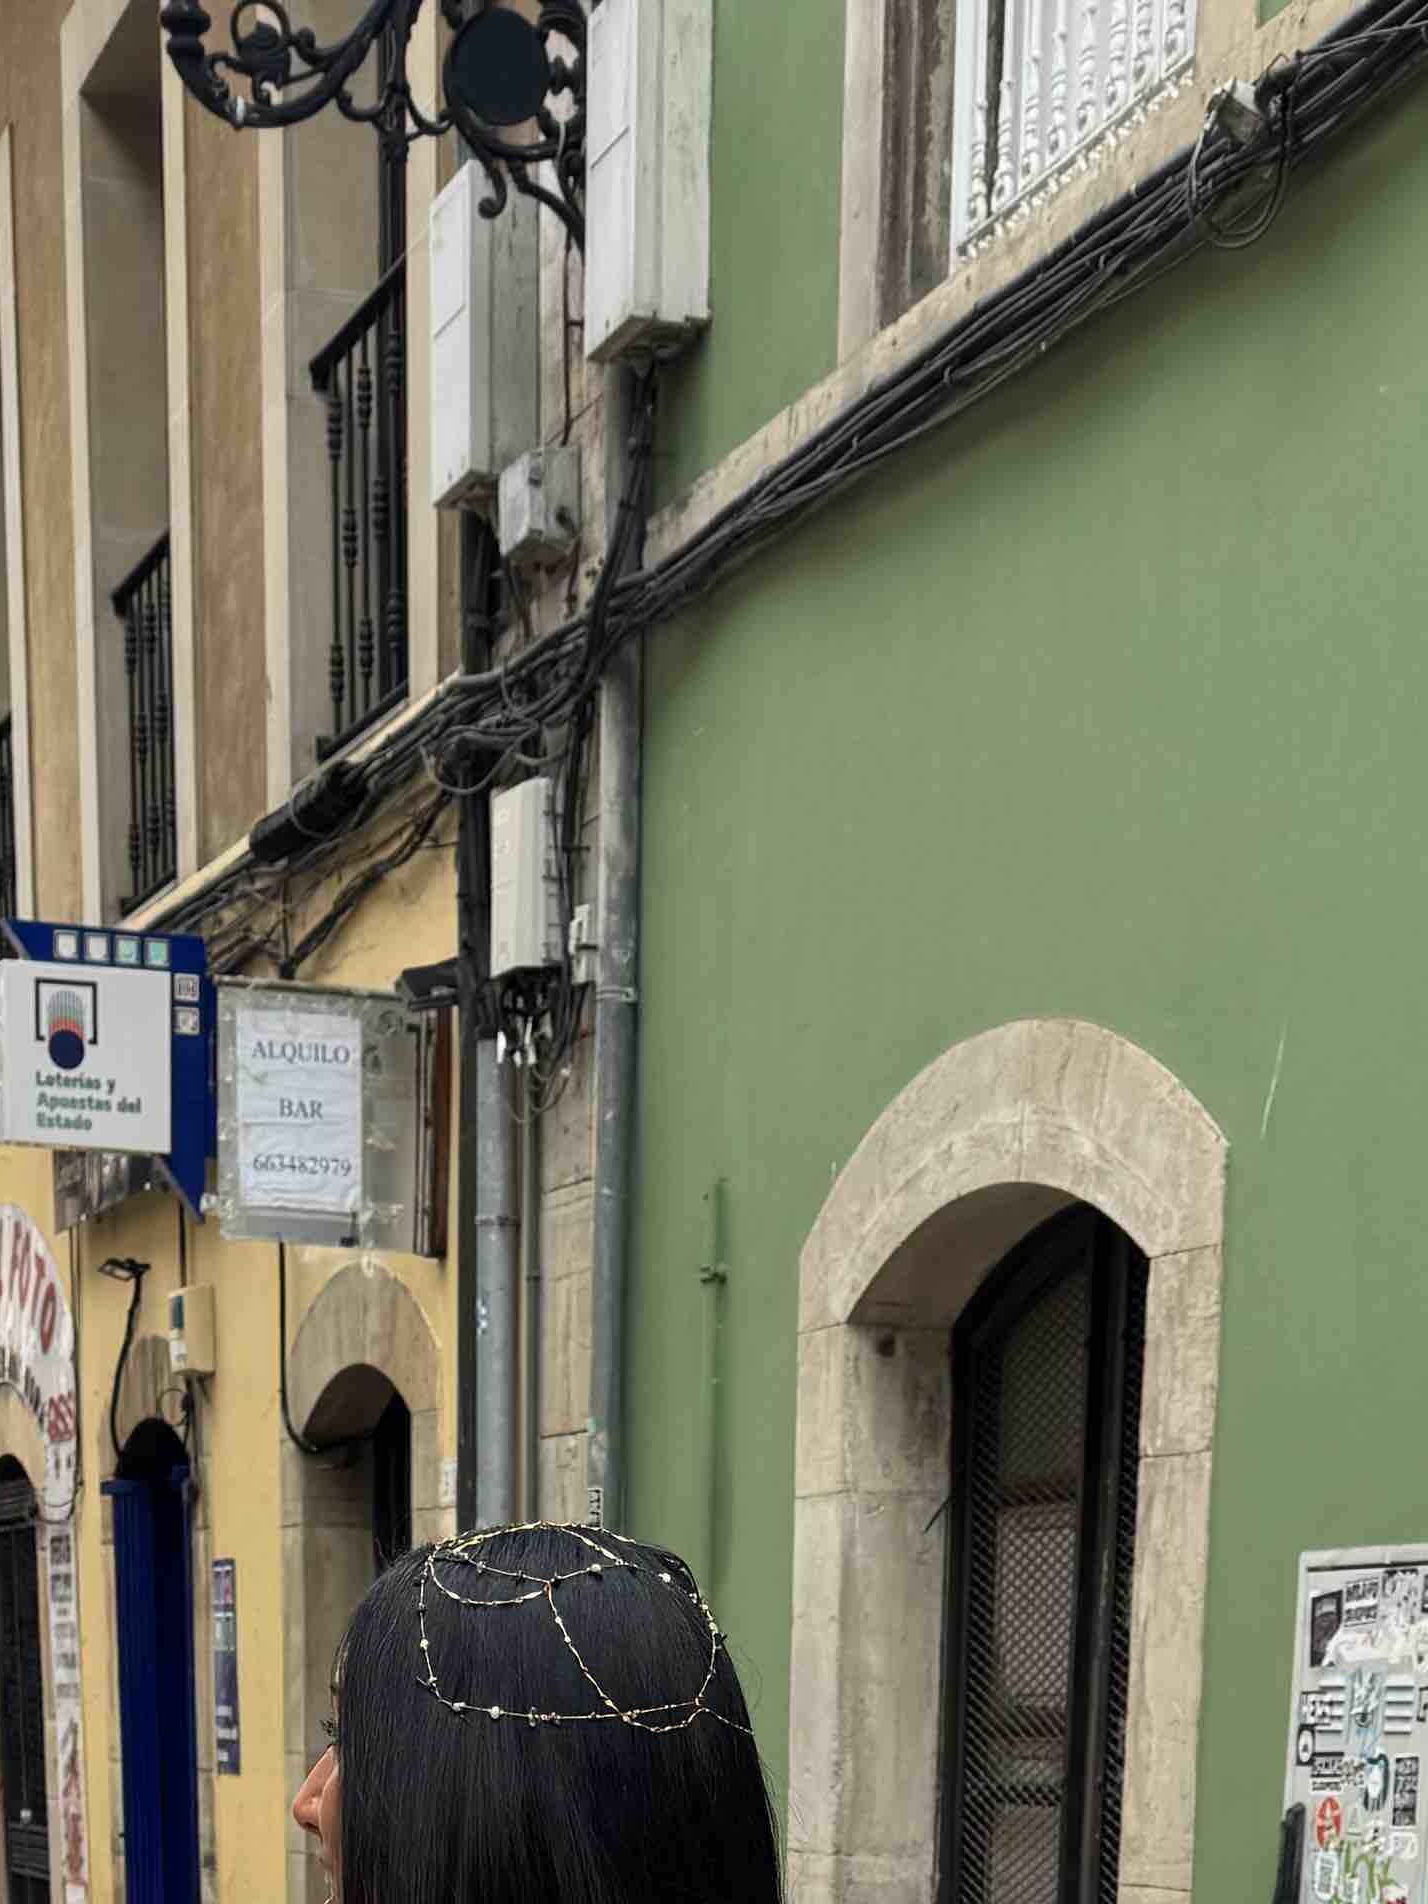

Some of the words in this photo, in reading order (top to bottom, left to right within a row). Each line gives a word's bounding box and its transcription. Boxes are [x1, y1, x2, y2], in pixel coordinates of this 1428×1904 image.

[252, 1040, 351, 1064] ALQUILO
[35, 1069, 101, 1090] Loterías
[107, 1077, 116, 1094] y
[36, 1092, 112, 1112] Apuestas
[117, 1096, 141, 1113] del
[279, 1096, 323, 1120] BAR
[36, 1112, 93, 1131] Estado
